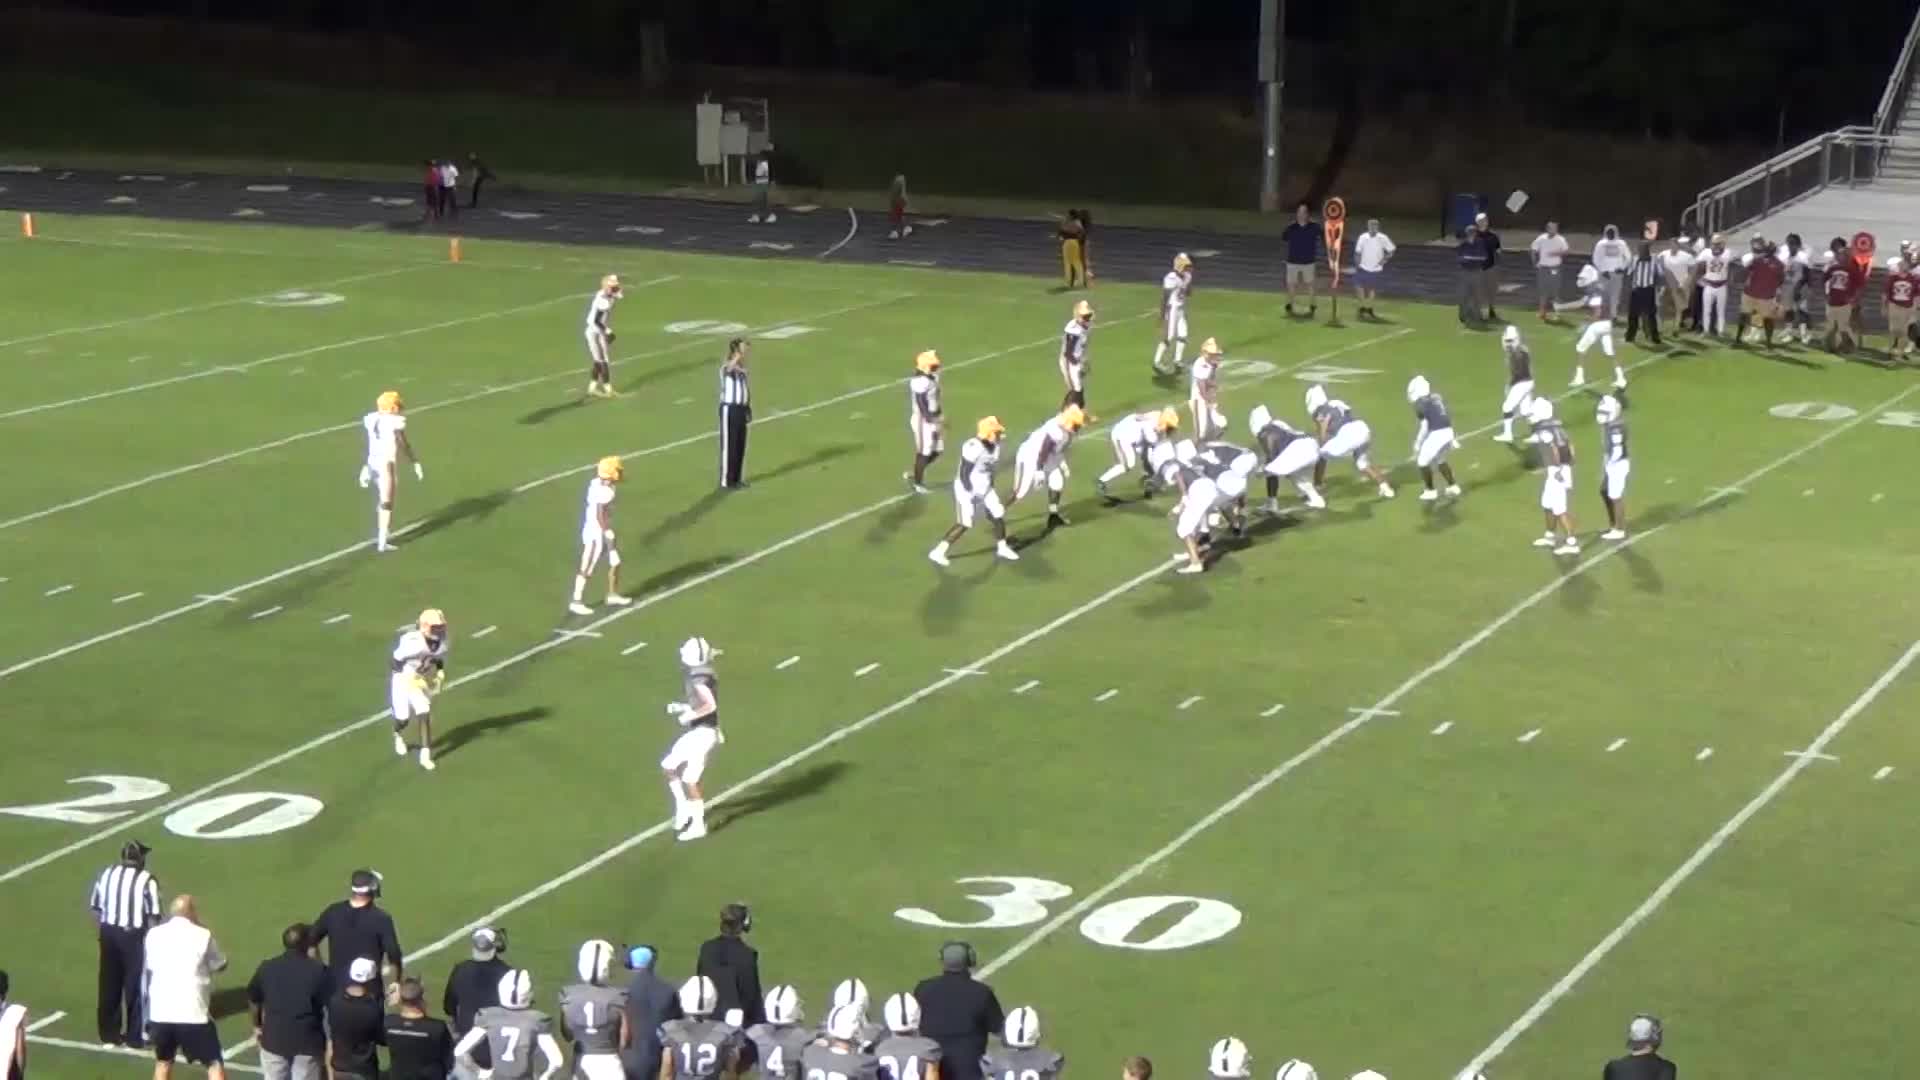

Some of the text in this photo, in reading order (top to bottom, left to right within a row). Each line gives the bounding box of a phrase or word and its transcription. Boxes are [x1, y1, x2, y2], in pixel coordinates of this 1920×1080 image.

[894, 876, 1242, 949] 30
[582, 1001, 601, 1035] 1
[501, 1026, 521, 1062] 7
[681, 1042, 717, 1076] 12
[766, 1045, 785, 1077] 4
